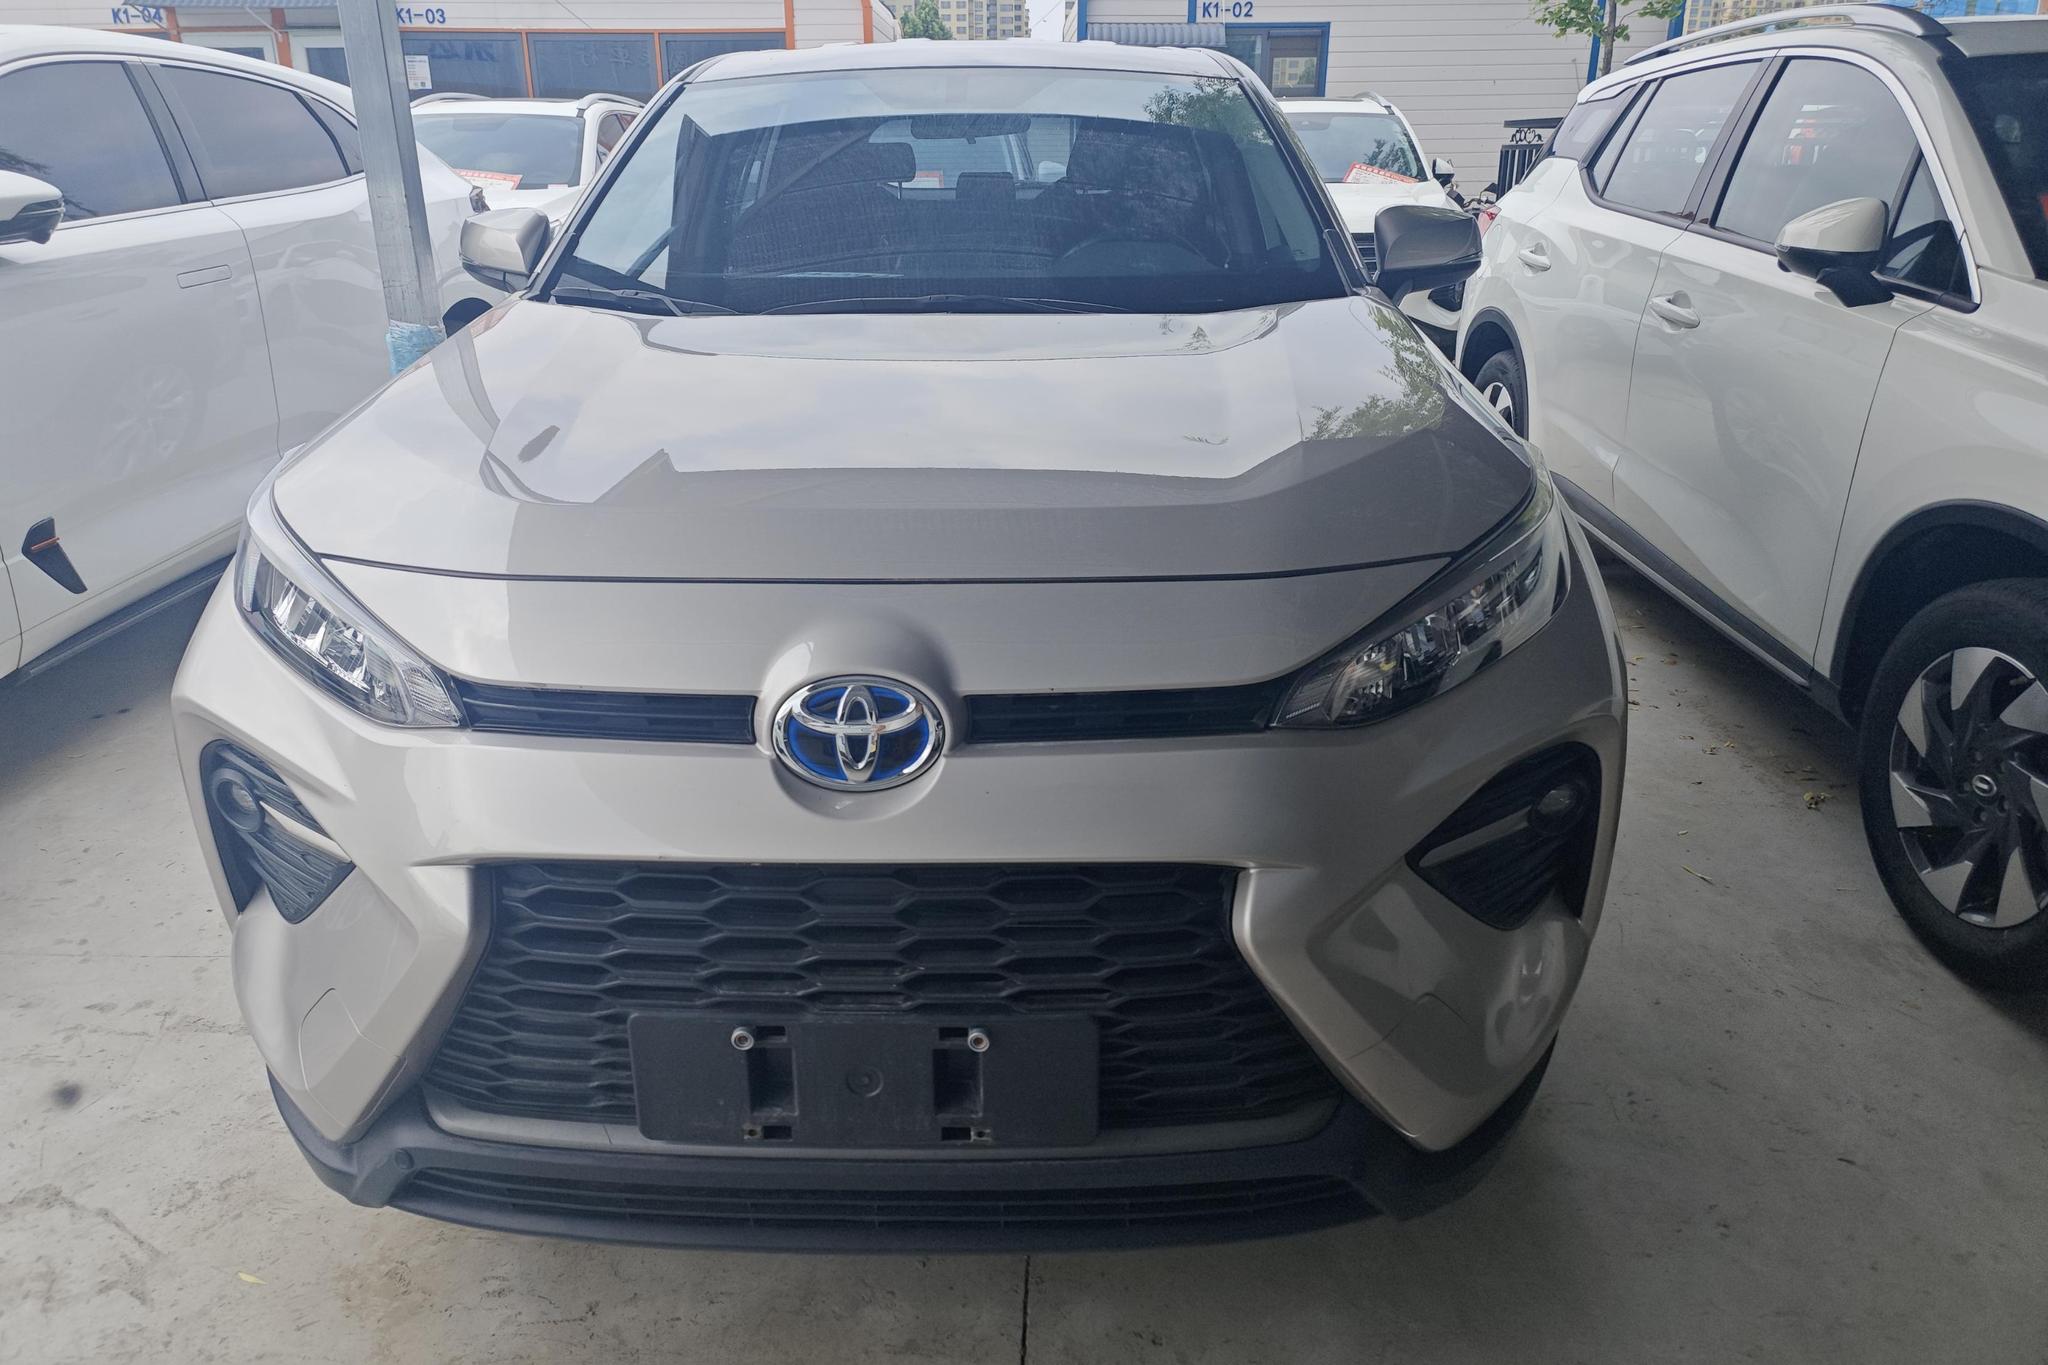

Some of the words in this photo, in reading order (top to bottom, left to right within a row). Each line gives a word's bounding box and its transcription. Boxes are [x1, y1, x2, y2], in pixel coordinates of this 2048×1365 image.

[111, 6, 163, 24] K1-04
[395, 8, 446, 24] K1-03
[1202, 1, 1253, 18] K1-02
